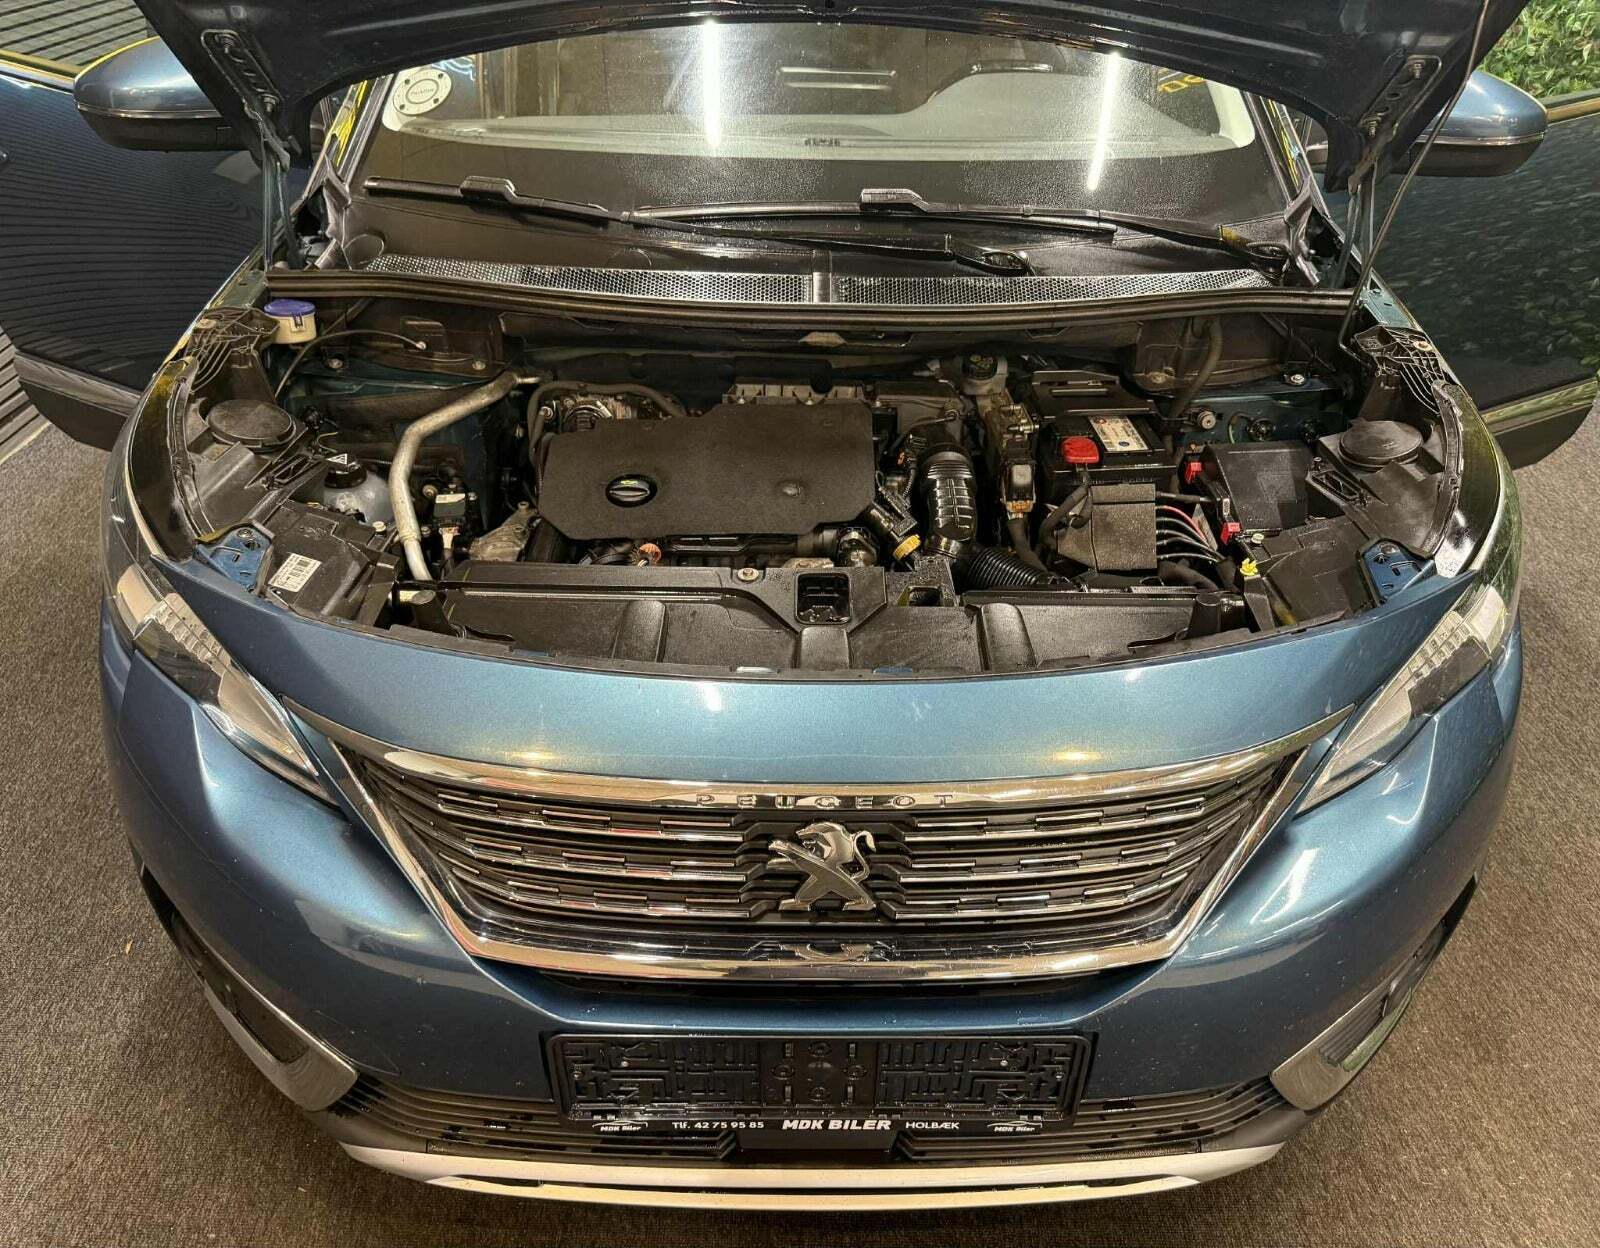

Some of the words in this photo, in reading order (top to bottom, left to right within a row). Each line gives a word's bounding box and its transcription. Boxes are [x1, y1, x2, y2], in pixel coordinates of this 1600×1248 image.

[696, 793, 953, 809] PEUGEOT
[672, 1121, 690, 1129] Tlf.
[694, 1121, 710, 1129] 42
[712, 1121, 728, 1129] 75
[730, 1121, 746, 1129] 95
[749, 1121, 764, 1129] 85
[782, 1119, 823, 1130] MDK
[828, 1119, 892, 1130] BILER
[905, 1121, 960, 1130] HOLBÆK
